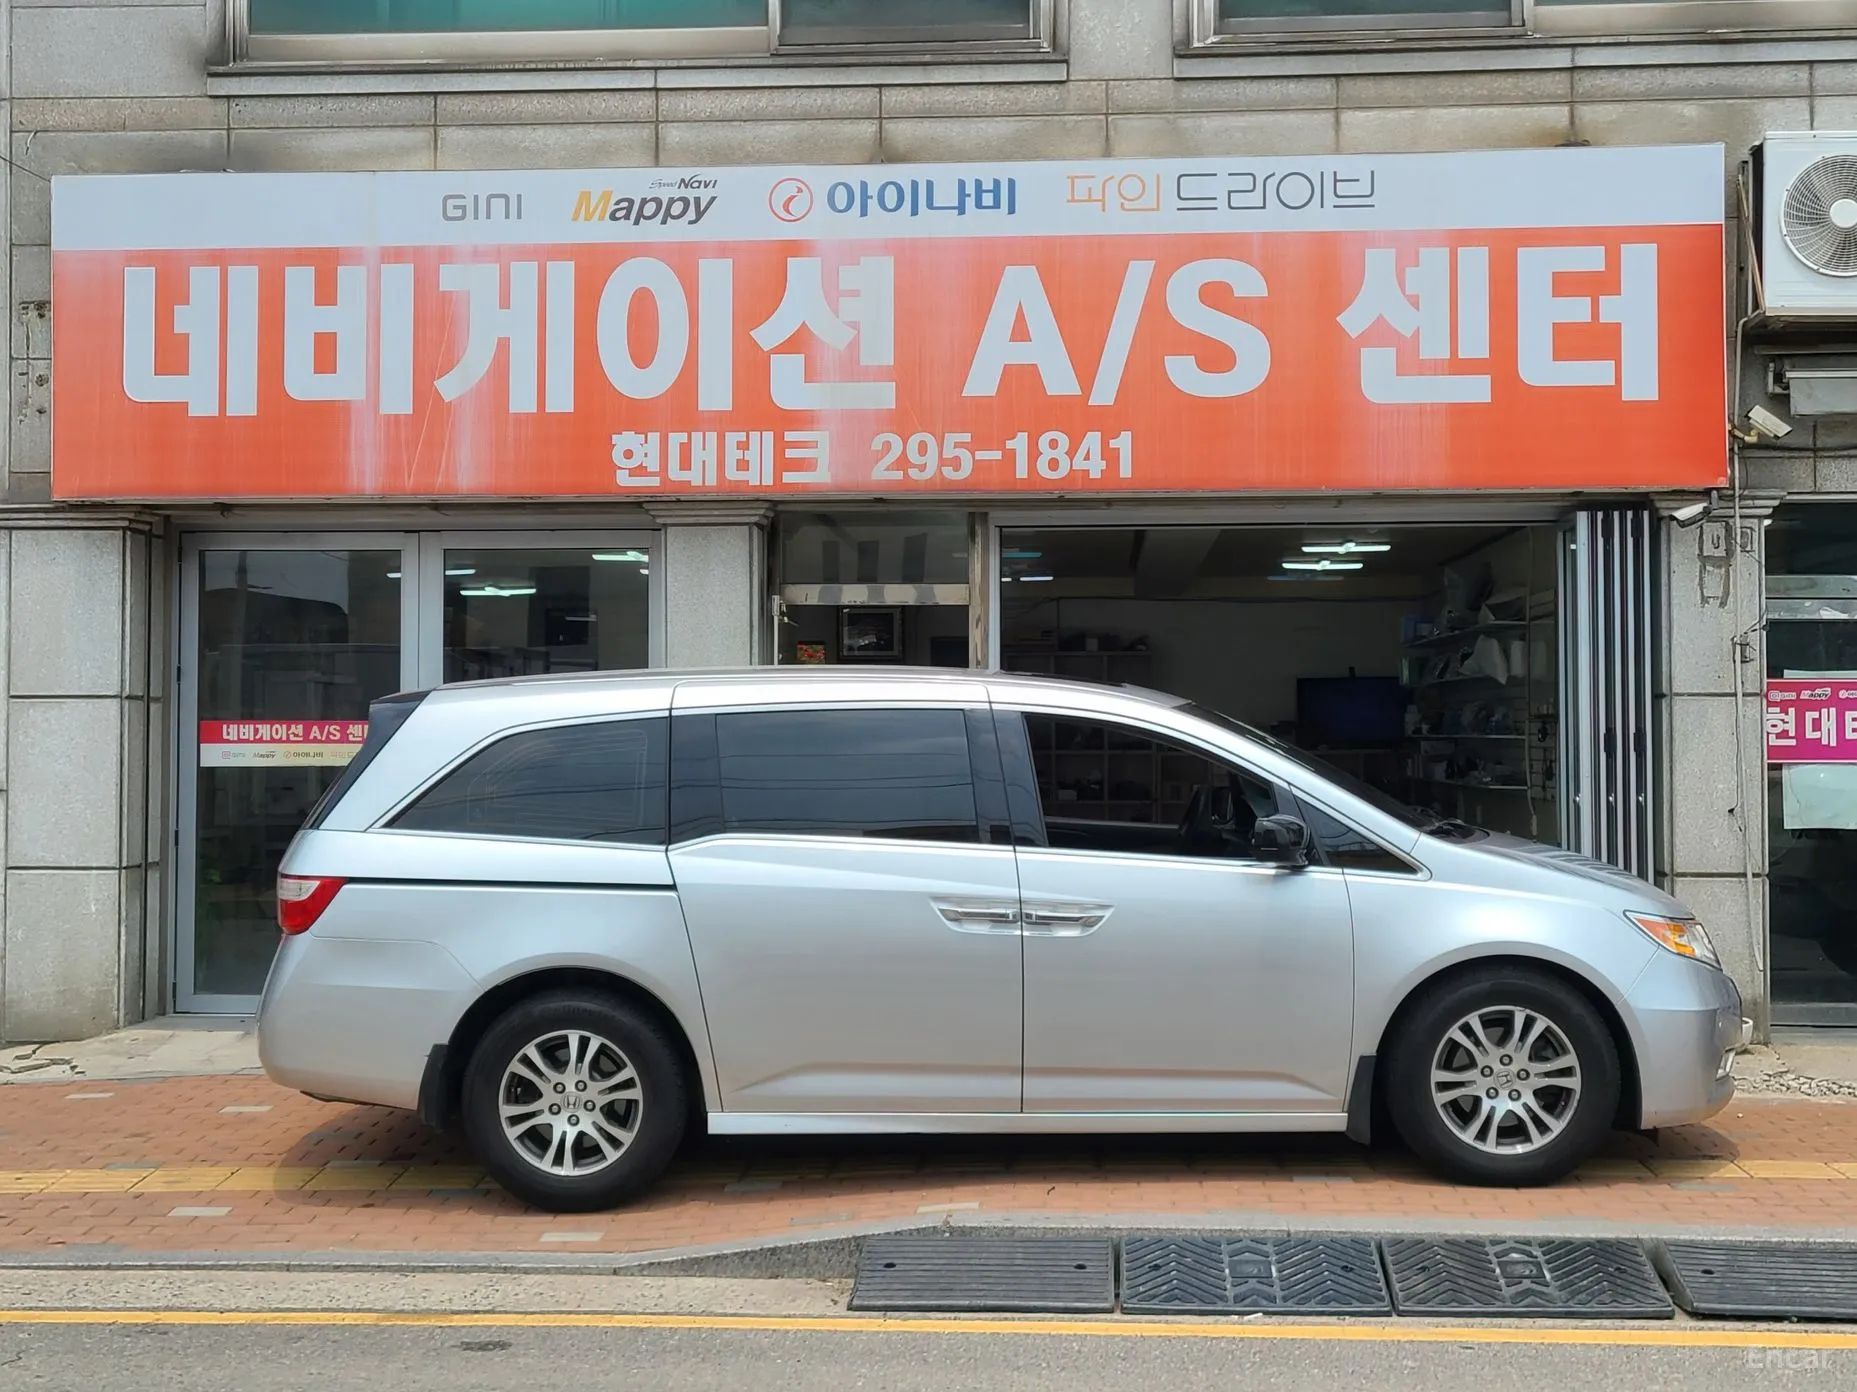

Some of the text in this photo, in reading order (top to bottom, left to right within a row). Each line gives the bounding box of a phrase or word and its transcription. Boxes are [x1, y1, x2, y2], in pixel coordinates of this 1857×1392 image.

[571, 190, 718, 226] Mappy
[826, 177, 1017, 218] 아이나비
[1066, 170, 1376, 212] 파인 드라이브
[123, 243, 1660, 417] 네비게이션 A/S 센터
[611, 430, 1134, 488] 현대테크 295-1841
[222, 723, 304, 741] 네비게이션
[309, 724, 341, 740] A/S
